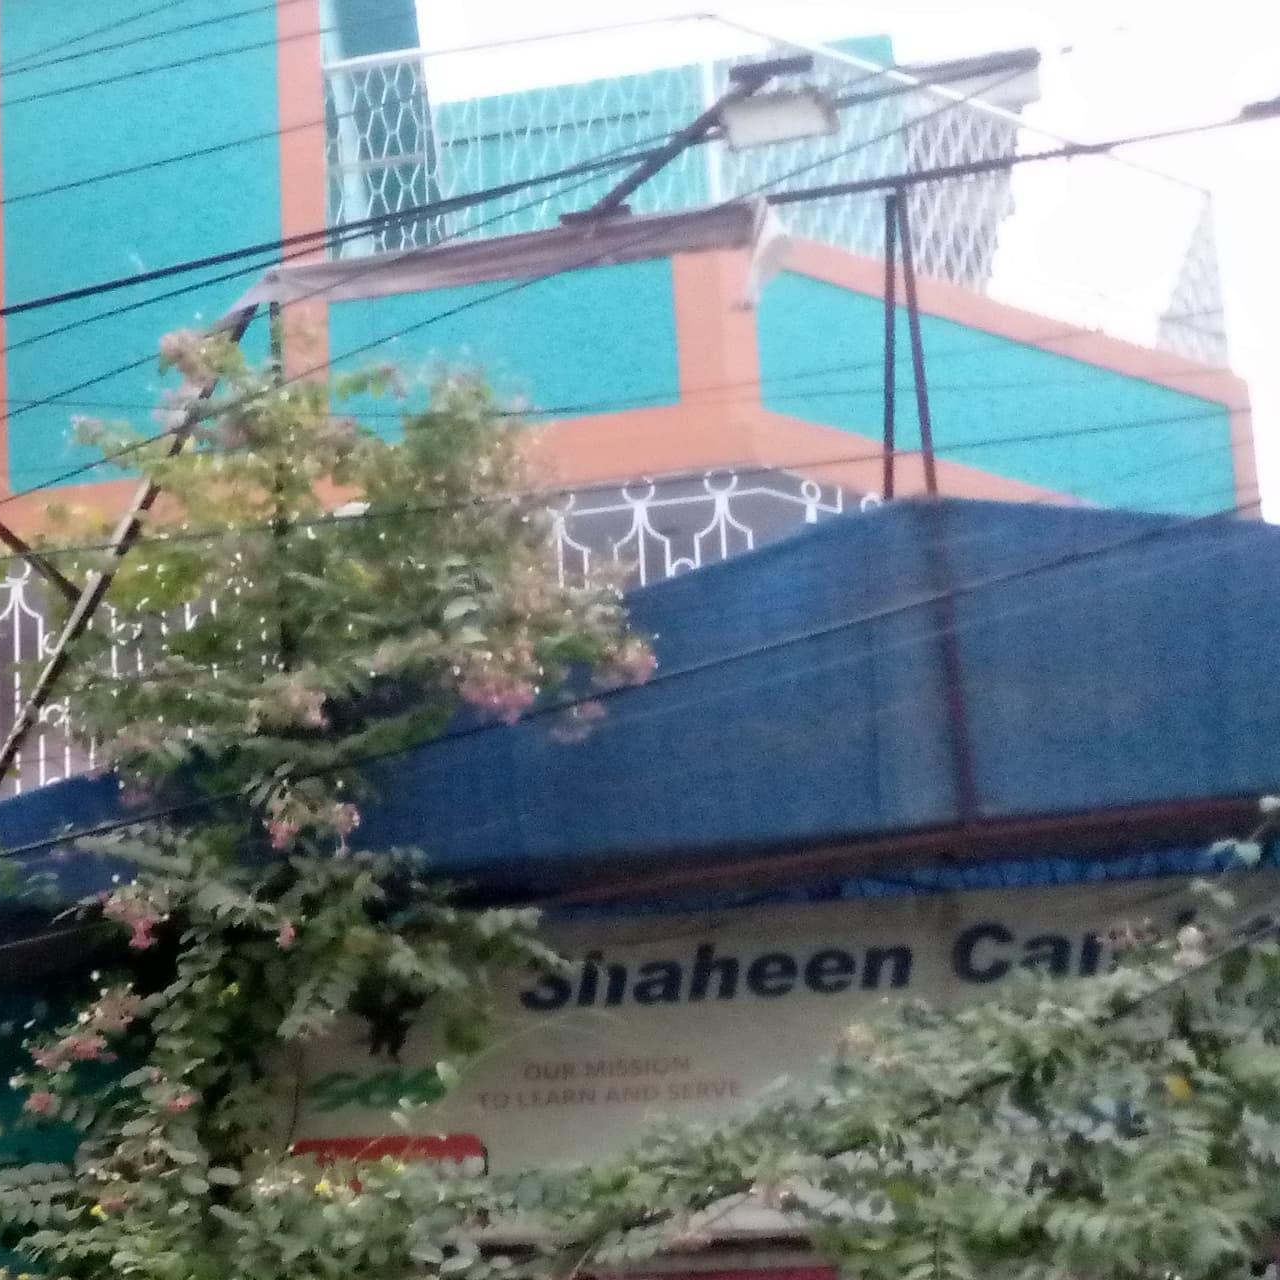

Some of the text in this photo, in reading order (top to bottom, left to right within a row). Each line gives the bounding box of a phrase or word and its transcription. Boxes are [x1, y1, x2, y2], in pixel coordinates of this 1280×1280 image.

[523, 1054, 691, 1081] OUR MISSION
[517, 1086, 597, 1109] LEARN
[606, 1083, 660, 1105] AND
[668, 1077, 740, 1101] SERVE
